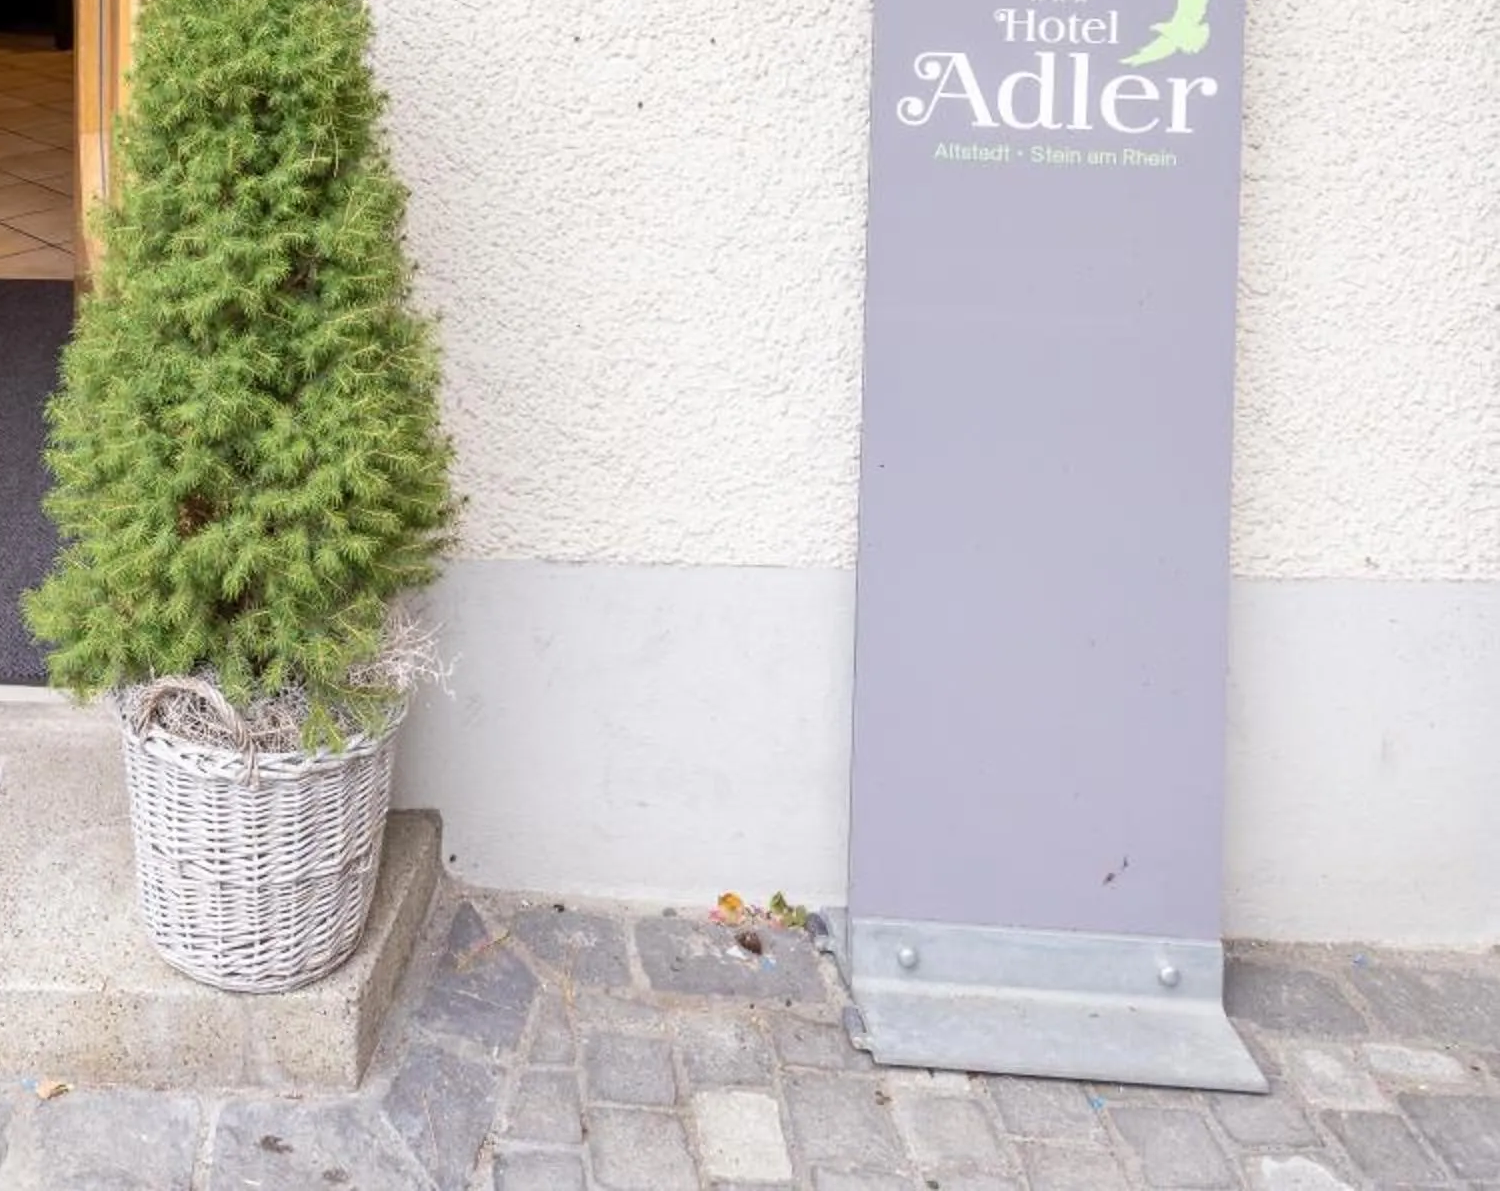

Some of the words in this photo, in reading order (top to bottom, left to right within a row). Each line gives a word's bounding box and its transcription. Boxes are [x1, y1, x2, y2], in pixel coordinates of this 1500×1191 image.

[994, 8, 1120, 45] Hotel
[896, 50, 1219, 134] Adler
[933, 142, 1011, 163] Altstadt
[1029, 144, 1086, 165] Stein
[1087, 150, 1118, 165] am
[1122, 147, 1178, 167] Rhein
